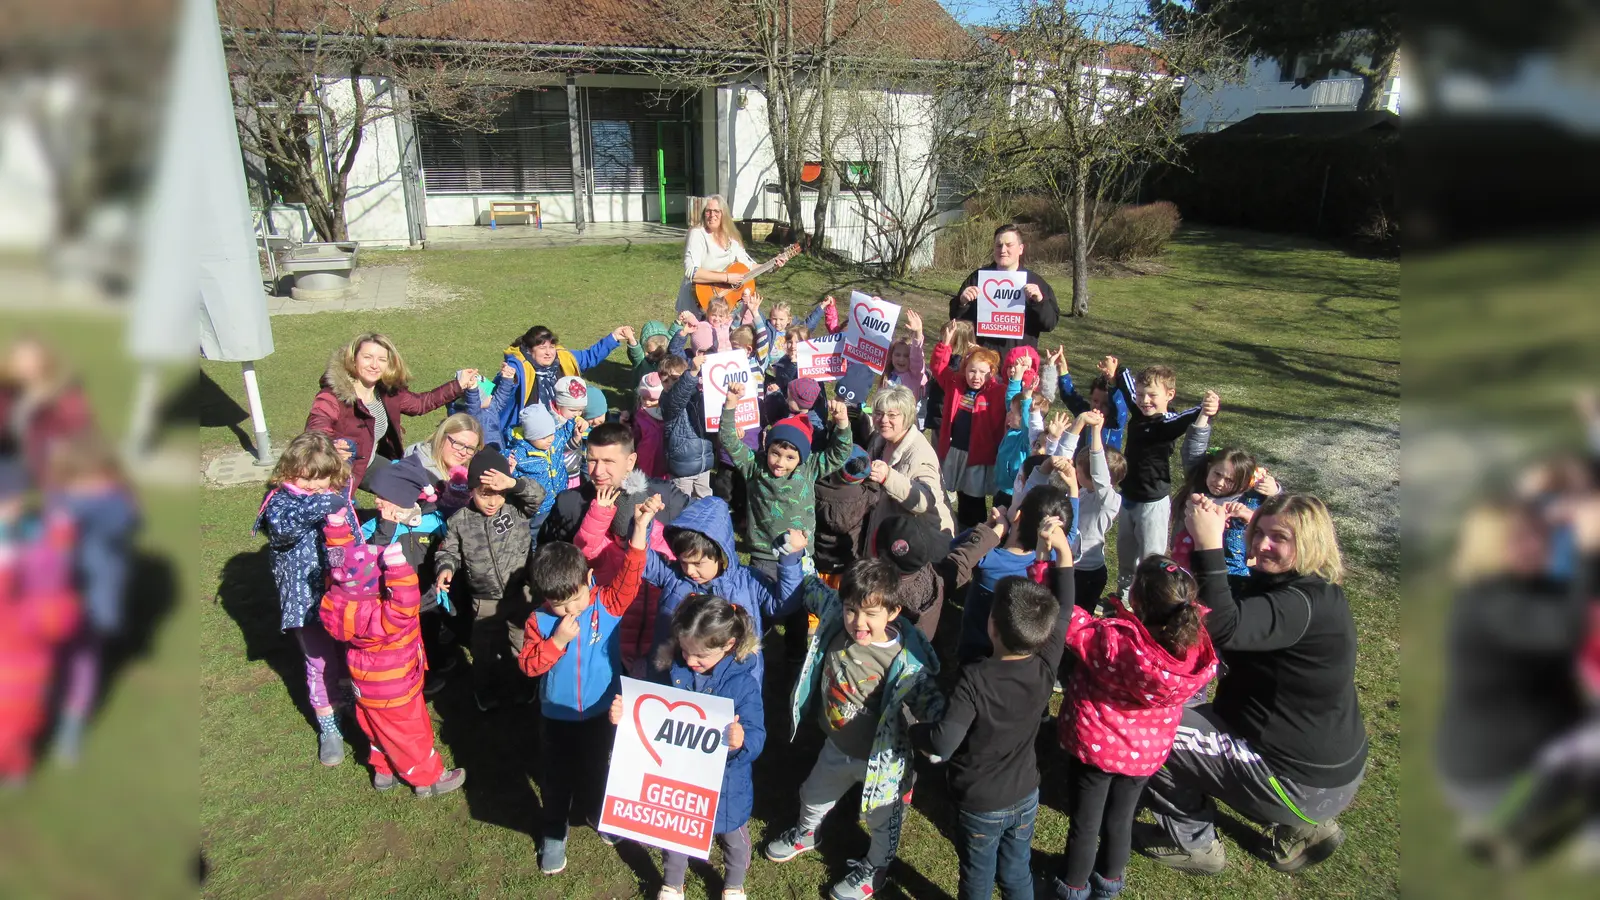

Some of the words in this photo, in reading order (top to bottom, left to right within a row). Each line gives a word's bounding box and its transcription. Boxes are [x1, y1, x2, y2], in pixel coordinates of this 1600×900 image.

[993, 289, 1021, 300] AWO
[862, 316, 890, 333] AWO
[994, 315, 1021, 324] GEGEN
[982, 324, 1020, 332] RASSISMUS!
[847, 346, 882, 366] RASSISMUS!
[860, 341, 884, 358] GEGEN
[814, 356, 842, 366] GEGEN
[722, 371, 748, 387] AWO
[802, 366, 843, 376] RASSISMUS!
[735, 401, 754, 413] GEN
[492, 512, 515, 535] 52
[654, 718, 721, 754] AWO
[646, 783, 710, 816] GEGEN
[612, 800, 704, 838] RASSISMUS!
